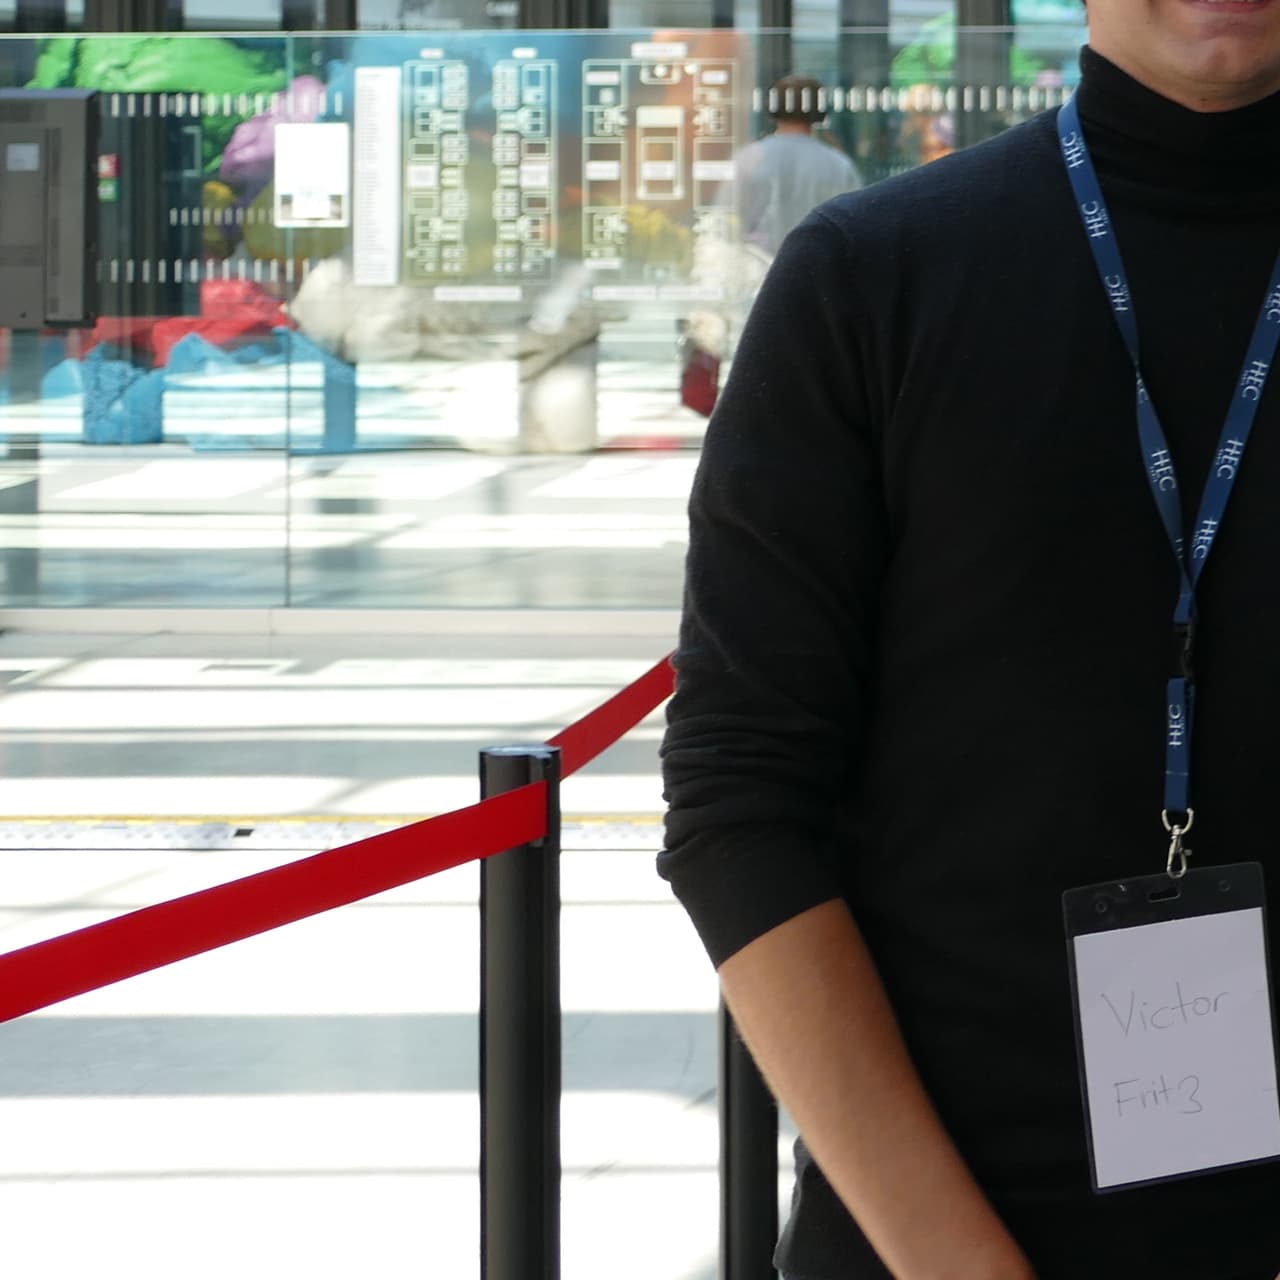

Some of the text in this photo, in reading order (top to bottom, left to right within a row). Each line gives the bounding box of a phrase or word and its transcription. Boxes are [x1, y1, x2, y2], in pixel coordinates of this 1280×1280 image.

[1062, 131, 1084, 168] HEC
[1081, 201, 1108, 238] HEC
[1104, 275, 1129, 311] HEC
[1241, 361, 1269, 401] HEC
[1151, 449, 1176, 491] HEC
[1217, 439, 1244, 480] HEC
[1193, 519, 1218, 559] HEC
[1168, 703, 1182, 745] HEC
[1100, 981, 1231, 1037] Victor
